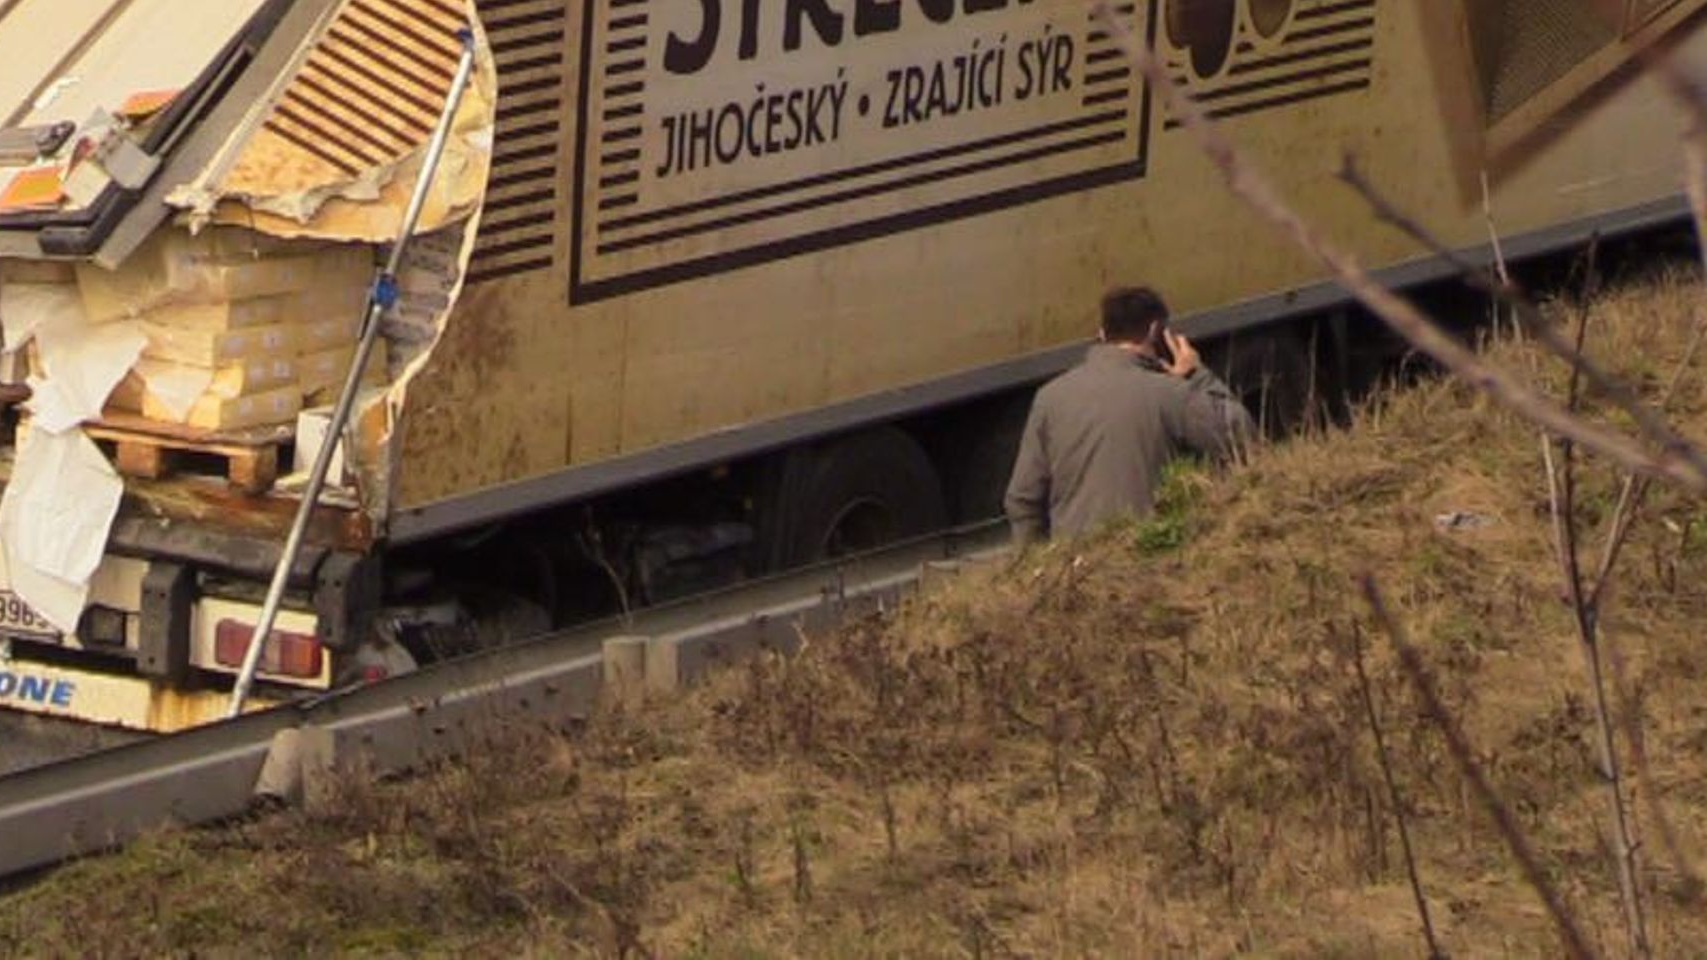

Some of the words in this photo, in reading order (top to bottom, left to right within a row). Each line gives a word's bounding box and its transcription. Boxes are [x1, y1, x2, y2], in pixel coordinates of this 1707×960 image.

[655, 67, 849, 180] JIHOČESKÝ
[882, 30, 1009, 130] ZRAJÍCÍ
[1014, 22, 1076, 101] SÝR
